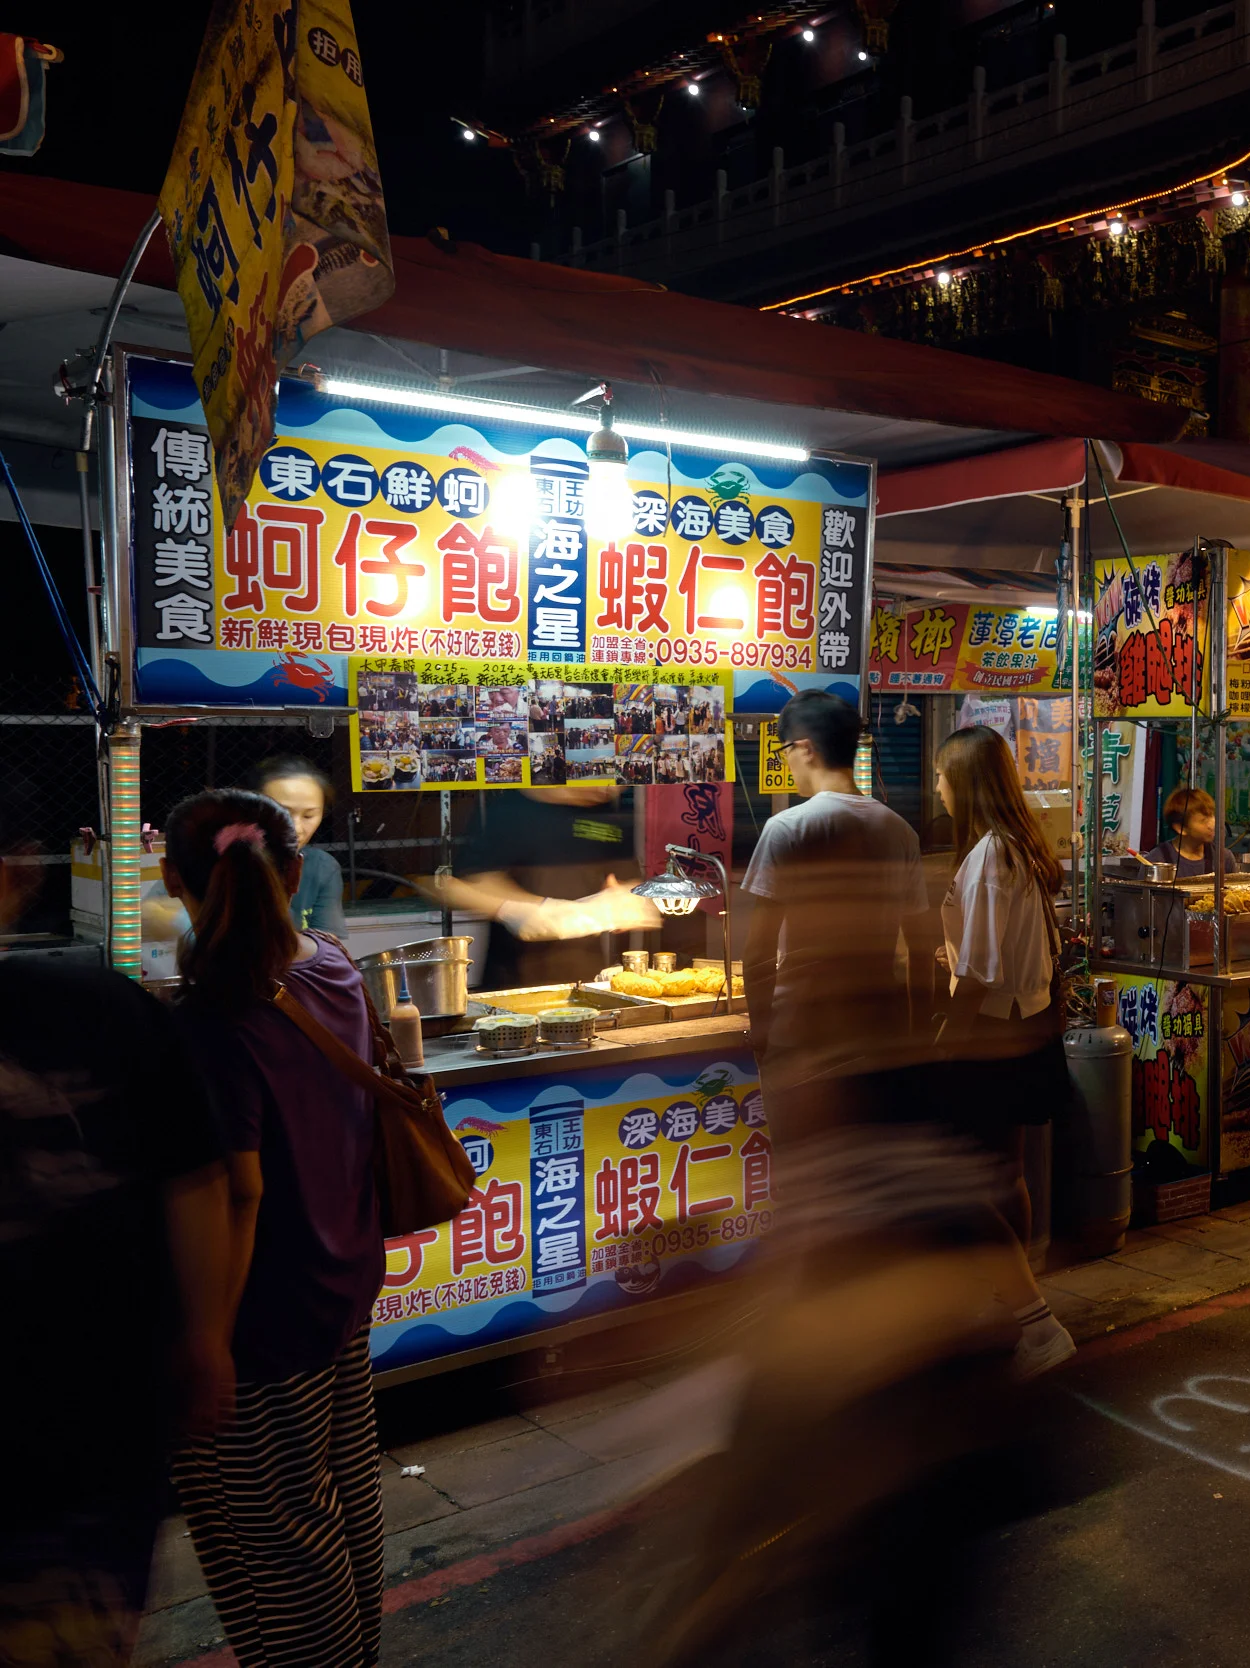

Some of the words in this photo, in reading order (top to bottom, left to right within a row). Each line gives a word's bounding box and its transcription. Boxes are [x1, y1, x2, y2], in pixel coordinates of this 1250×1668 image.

[267, 454, 486, 514] 東石鮮蚵
[151, 427, 213, 644] 傳統美食
[632, 497, 793, 547] 深海美食
[224, 502, 522, 624] 蚵仔飽
[532, 519, 584, 649] 海之星
[596, 543, 817, 640] 蝦仁飽
[819, 508, 856, 668] 歡迎外帶
[591, 635, 647, 650] 加盟全省
[968, 611, 1058, 650] 蓮潭老店
[528, 650, 586, 663] 拒用回鍋油
[591, 650, 647, 664] 連鎖專線
[981, 652, 1038, 669] 茶飲果汁
[1119, 618, 1203, 707] 雞腿排
[765, 775, 783, 787] 60
[533, 1123, 553, 1156] 東石
[562, 1116, 582, 1152] 王功
[620, 1098, 767, 1148] 深海美食
[534, 1155, 582, 1274] 海之星
[644, 1209, 776, 1258] :0935-8979
[592, 1239, 643, 1261] 加盟全省
